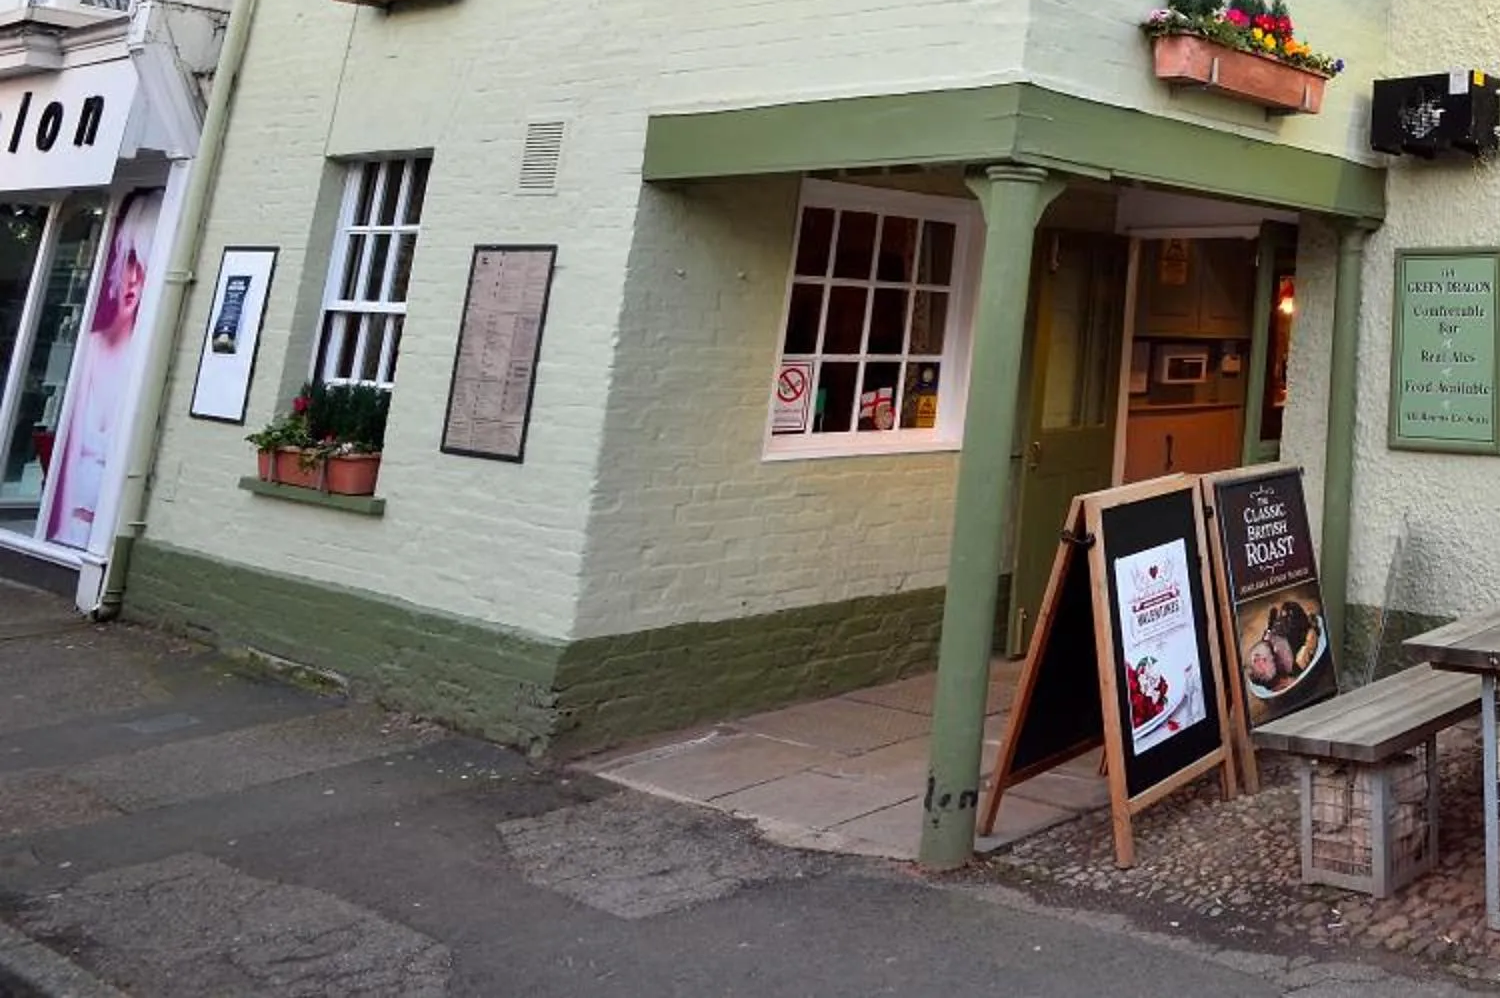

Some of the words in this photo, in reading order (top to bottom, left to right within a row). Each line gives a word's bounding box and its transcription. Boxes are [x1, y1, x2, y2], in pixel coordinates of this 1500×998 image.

[0, 91, 105, 154] lon
[1407, 282, 1443, 293] GREEN
[1447, 281, 1491, 293] DRAGON
[1243, 503, 1287, 523] CLASSIC
[1247, 520, 1288, 541] BRITISH
[1244, 535, 1295, 567] ROAST
